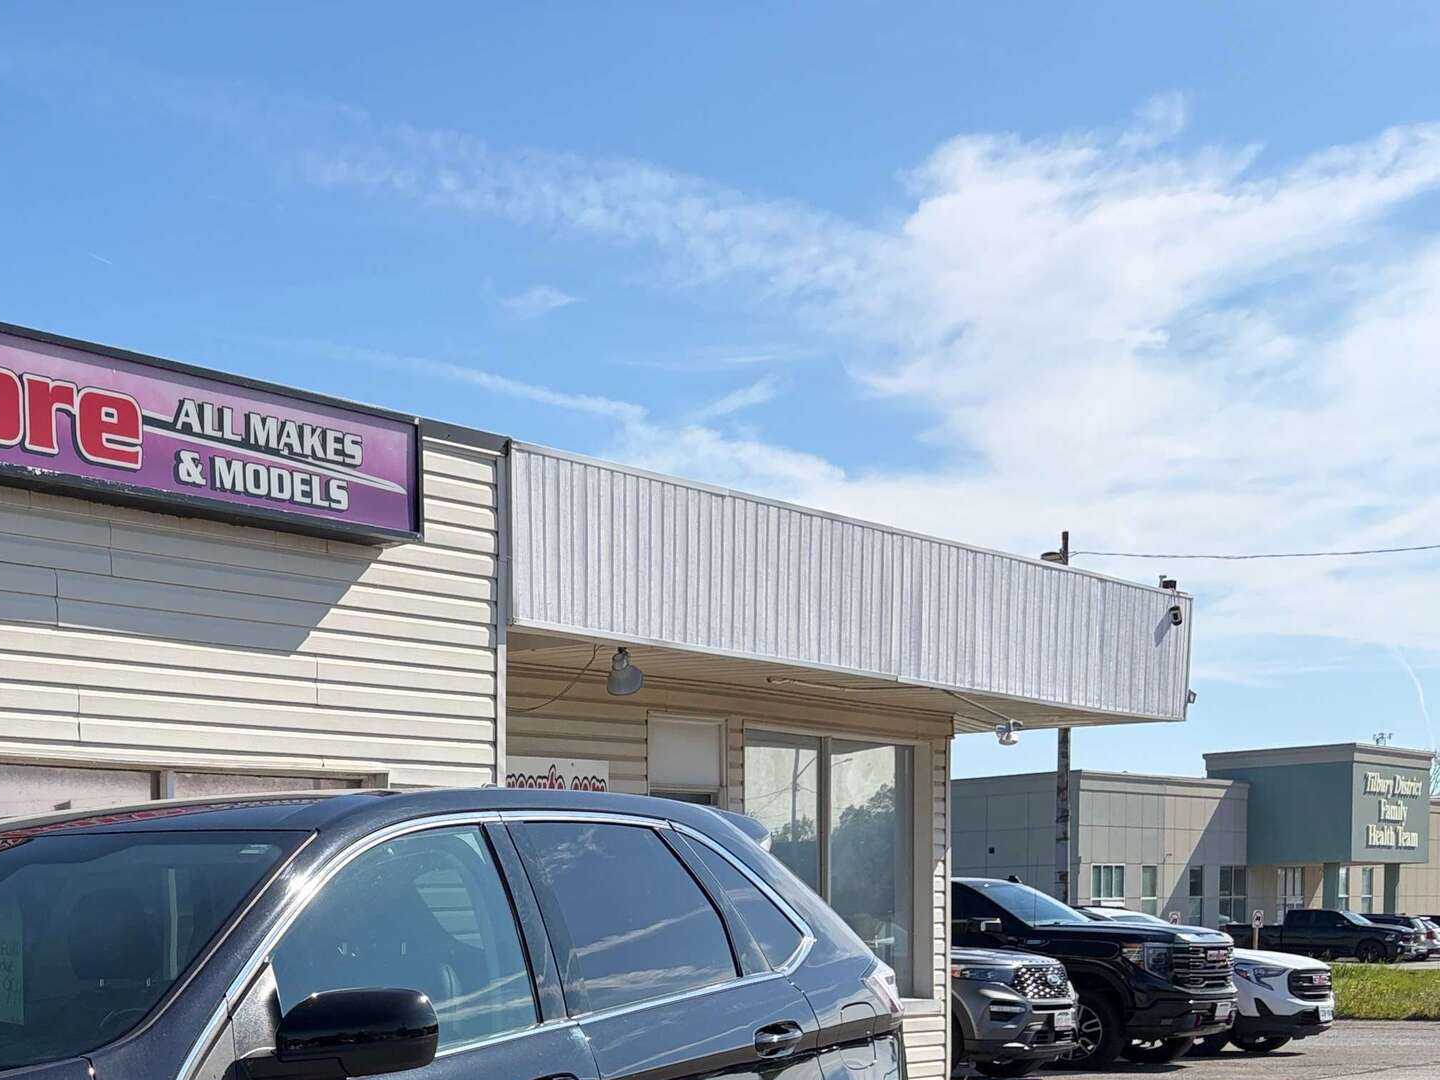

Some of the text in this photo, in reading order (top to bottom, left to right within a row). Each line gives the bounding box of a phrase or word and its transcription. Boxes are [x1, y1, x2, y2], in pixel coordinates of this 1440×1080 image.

[173, 397, 364, 467] ALL MAKES
[176, 449, 349, 511] & MODELS
[1365, 772, 1422, 798] Tilbury District
[1379, 799, 1408, 826] Family
[1367, 824, 1419, 847] Health Team
